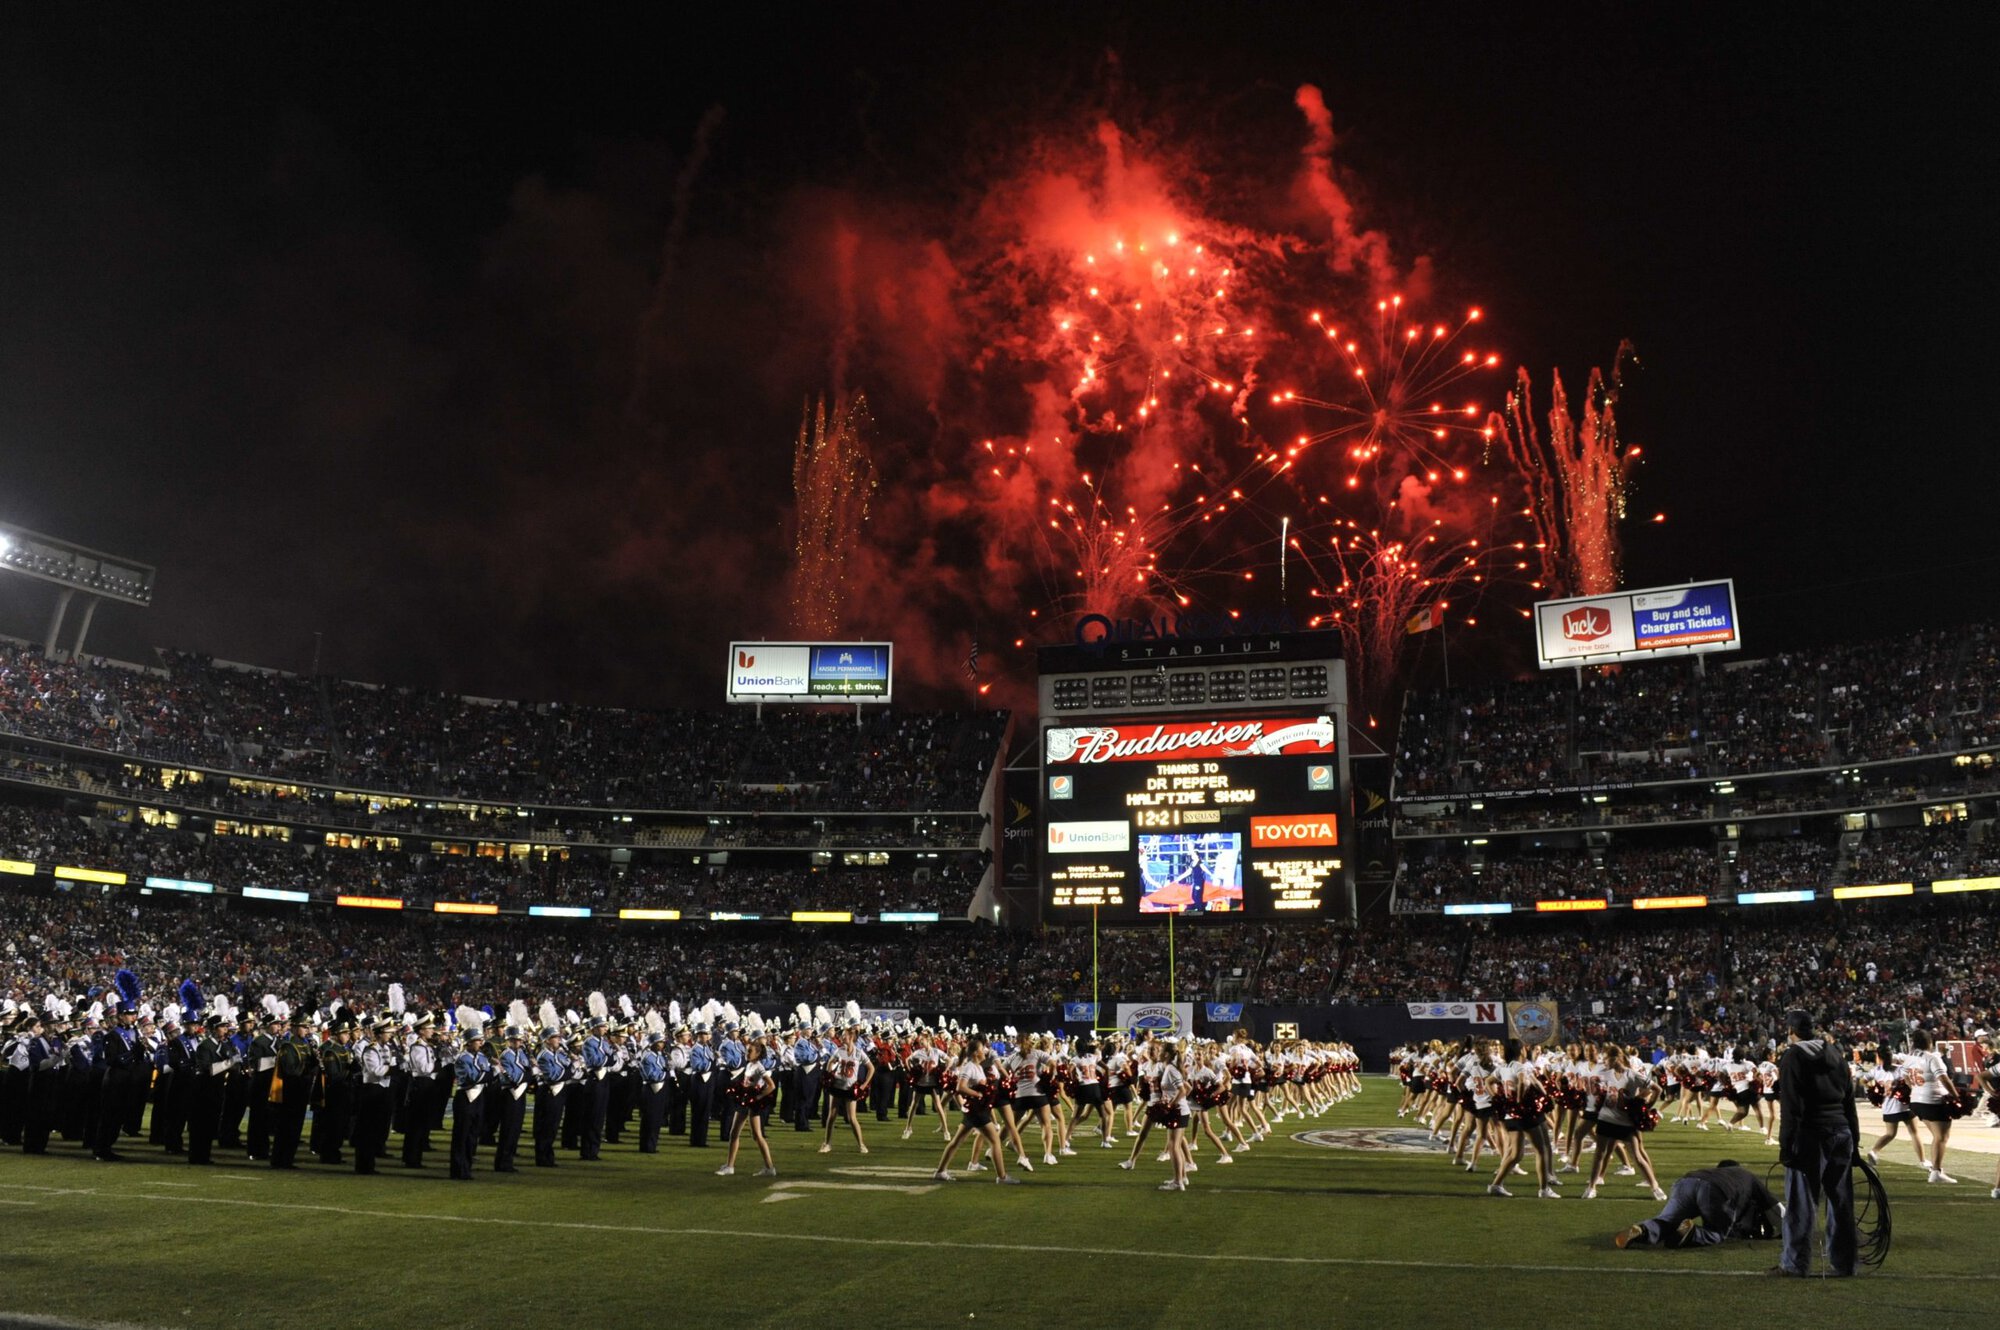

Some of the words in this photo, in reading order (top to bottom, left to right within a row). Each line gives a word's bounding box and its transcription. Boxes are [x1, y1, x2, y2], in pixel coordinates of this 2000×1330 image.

[1652, 610, 1672, 622] Buy
[1673, 607, 1691, 618] and
[1692, 605, 1712, 617] Sell
[1565, 609, 1610, 638] Jack
[1641, 622, 1685, 635] Chargers
[1687, 616, 1726, 629] Tickets!
[1121, 641, 1280, 658] STADIUM
[737, 676, 805, 686] UnionBank
[813, 683, 837, 691] ready.
[855, 682, 882, 691] thrive.
[1072, 721, 1263, 764] Budweiser
[1266, 731, 1304, 749] American
[1157, 763, 1199, 775] THANKS
[1203, 762, 1219, 774] TO
[1146, 777, 1168, 791] DR
[1173, 775, 1229, 789] PEPPER
[1126, 791, 1206, 806] HALFTIME
[1214, 789, 1256, 803] SHOW
[1255, 823, 1333, 840] TOYOTA
[1356, 817, 1389, 831] Sprint
[1004, 827, 1034, 840] Sprint
[1135, 1009, 1159, 1020] PACIFIC
[1476, 1004, 1496, 1022] N
[1276, 1023, 1295, 1039] 25
